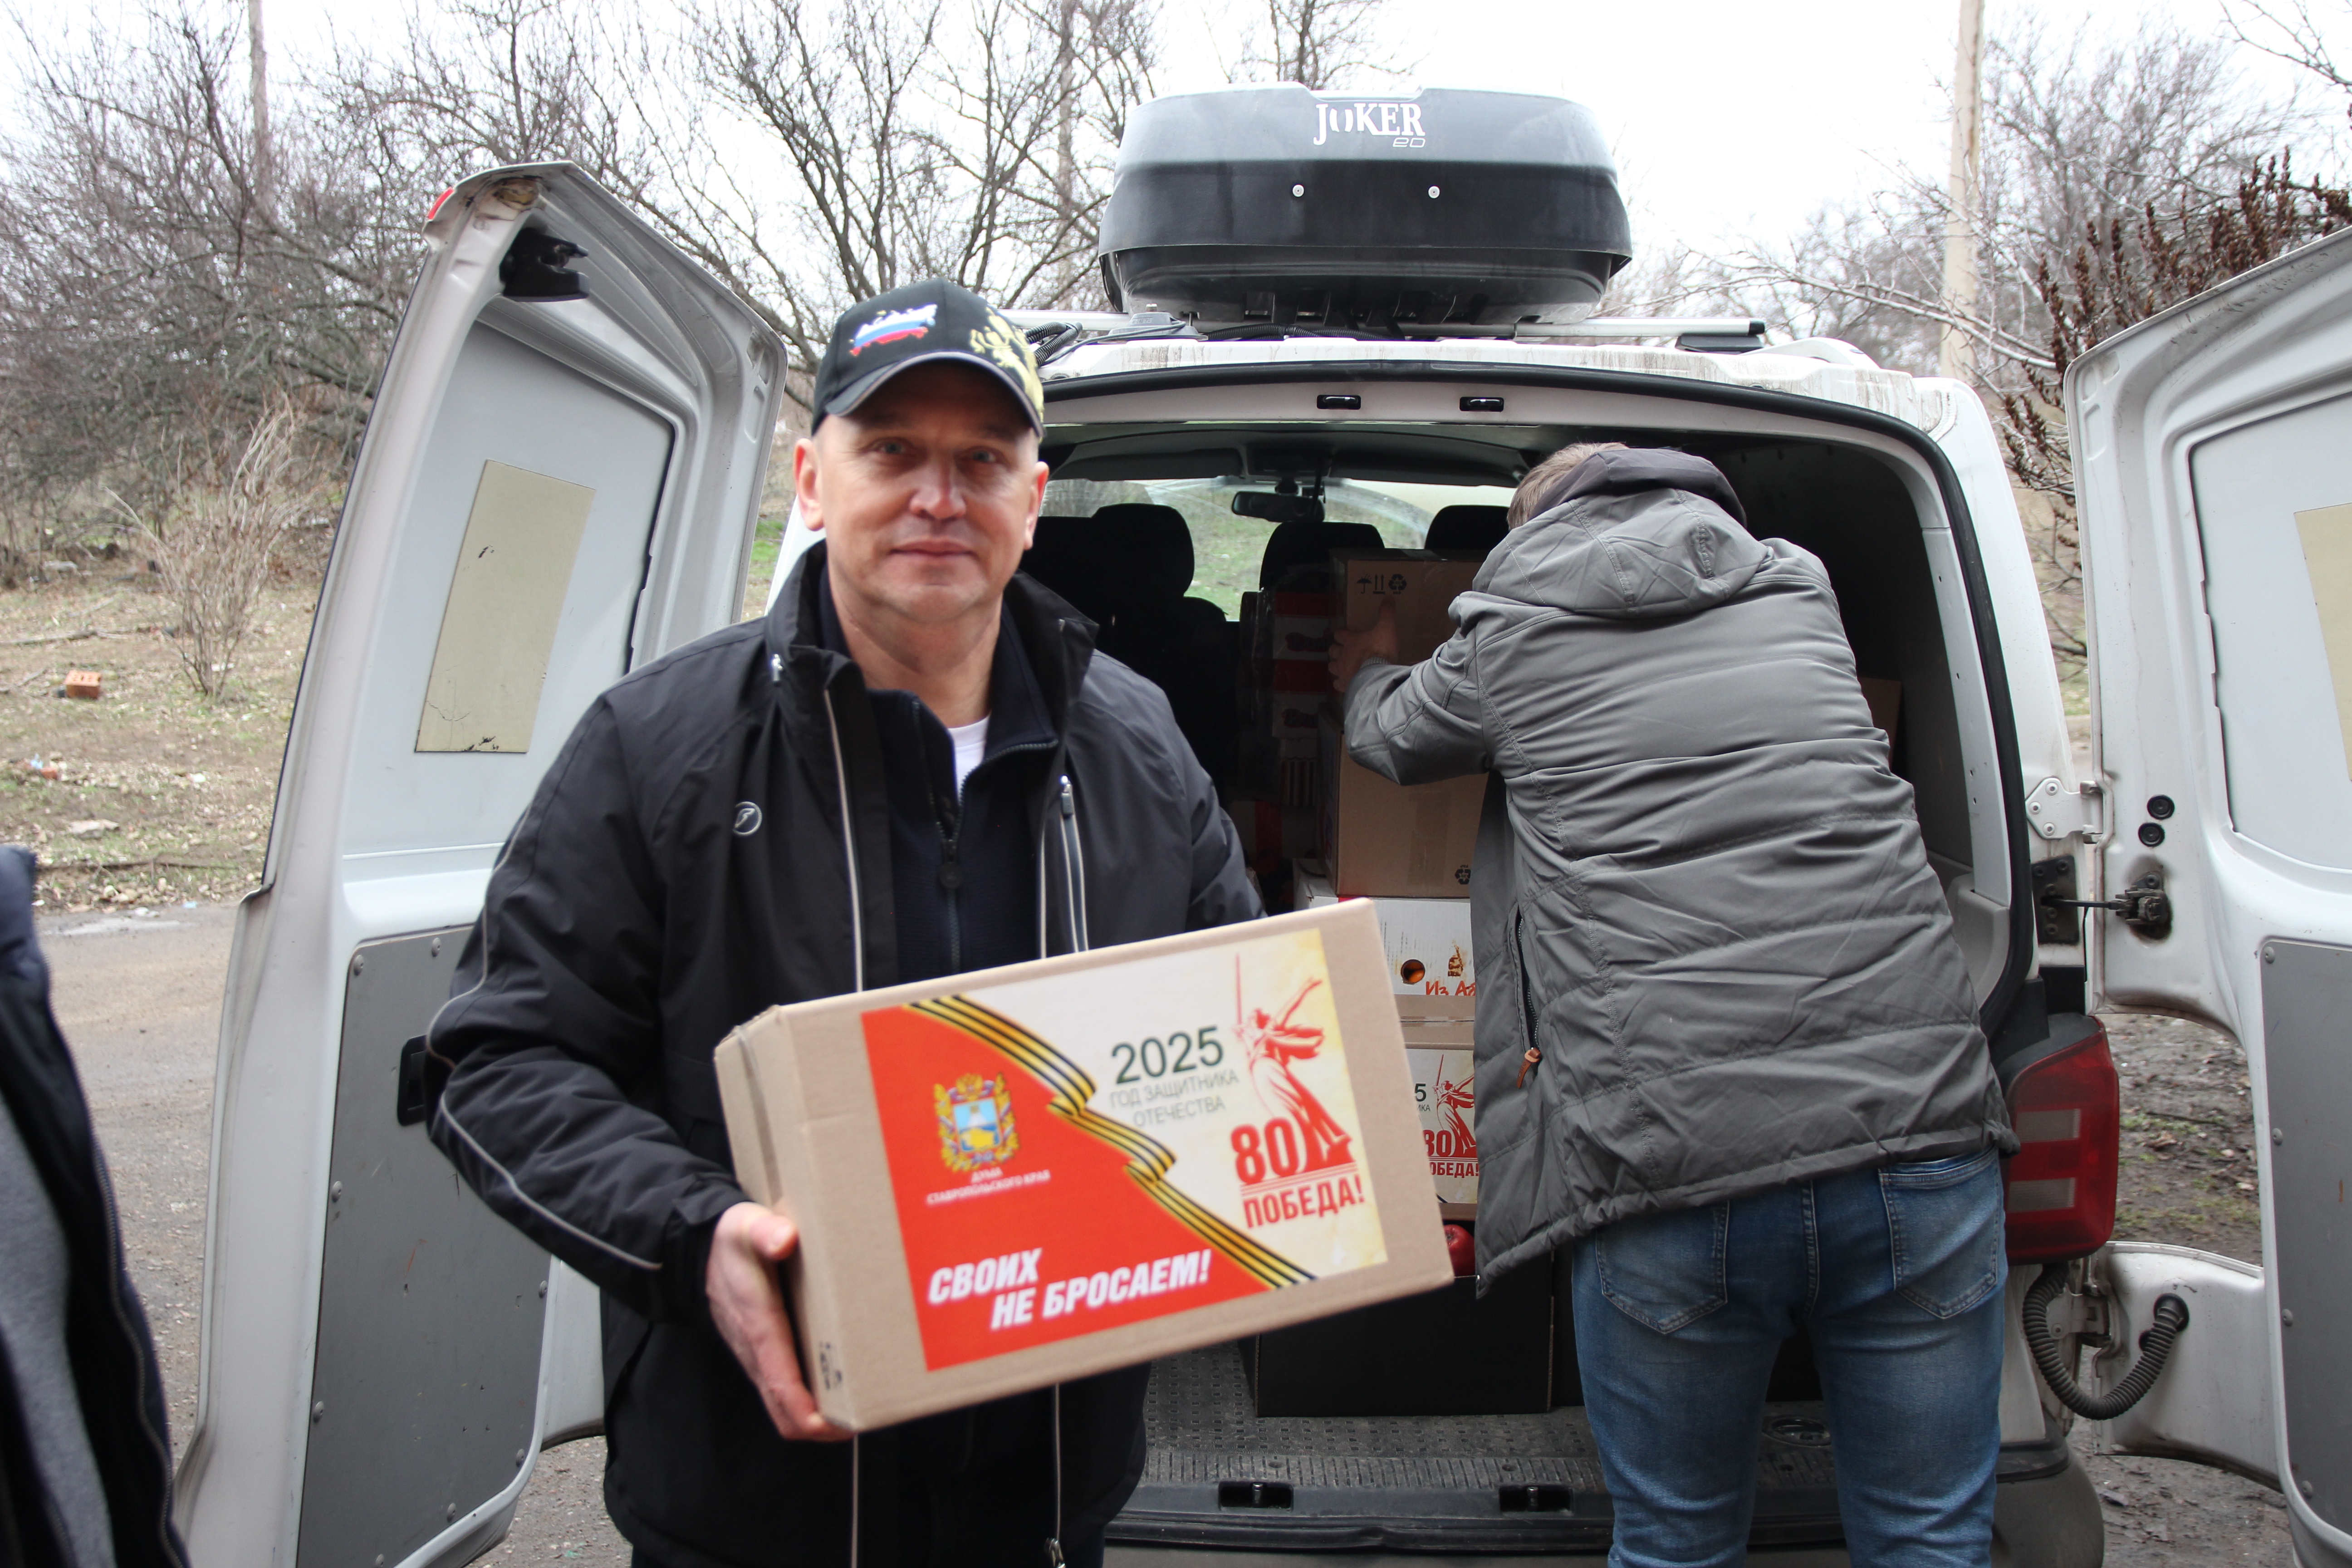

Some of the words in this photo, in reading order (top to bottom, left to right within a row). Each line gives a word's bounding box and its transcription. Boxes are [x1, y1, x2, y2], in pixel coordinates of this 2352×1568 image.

[1112, 1025, 1224, 1084] 2025
[1109, 1087, 1142, 1108] ГОД
[1144, 1069, 1239, 1101] ЗАЩИТНИКА
[1134, 1095, 1226, 1127] ОТЕЧЕСТВА
[1230, 1117, 1298, 1185] 80
[1430, 1162, 1479, 1178] ОБЕДА!
[1243, 1173, 1365, 1228] ПОБЕДА!
[928, 1247, 1042, 1305] СВОИХ
[990, 1287, 1037, 1331] НЕ
[1042, 1249, 1212, 1319] БРОСАЕМ!
